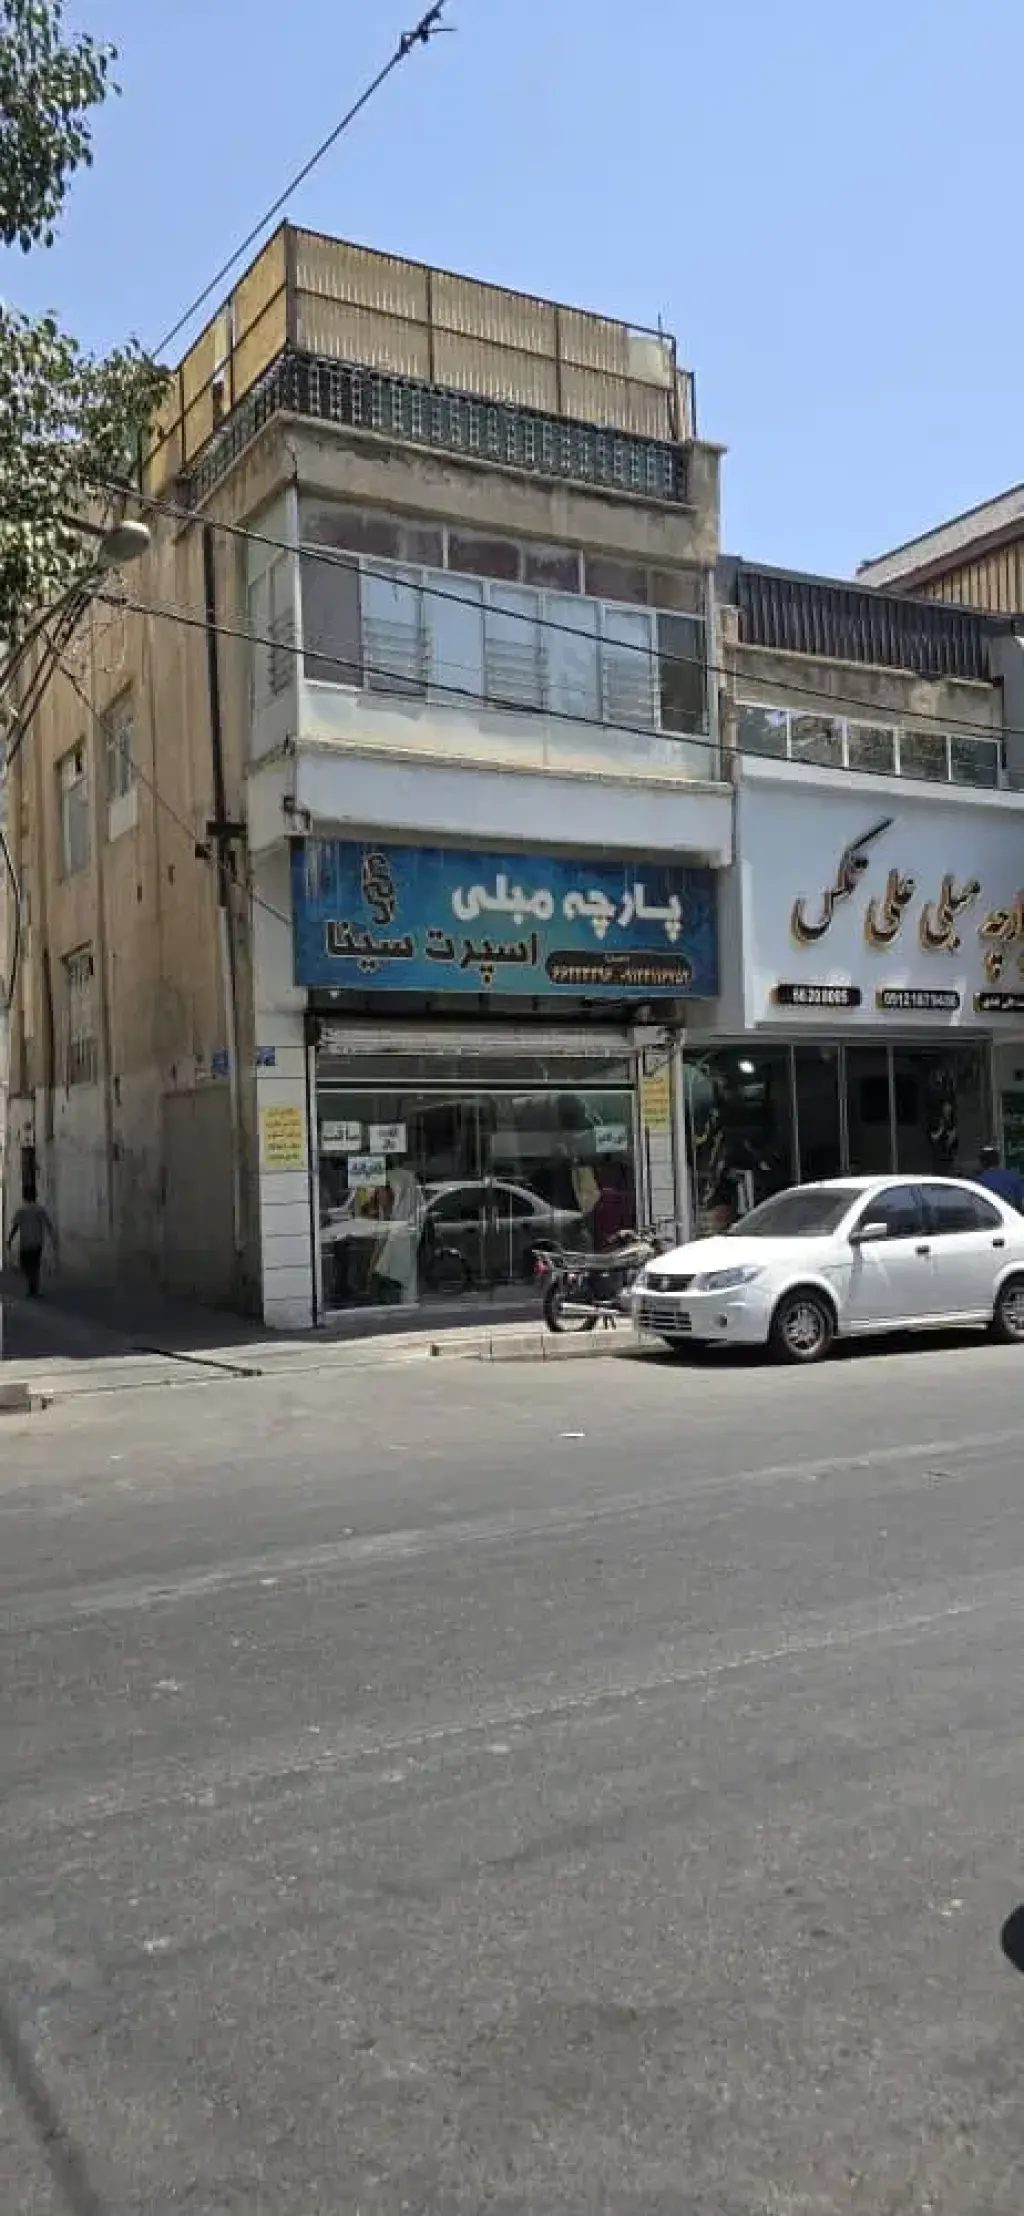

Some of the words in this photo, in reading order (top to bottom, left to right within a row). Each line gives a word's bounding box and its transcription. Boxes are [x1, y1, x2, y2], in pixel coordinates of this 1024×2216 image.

[451, 874, 554, 925] مبلی
[563, 883, 683, 941] پارچه
[790, 815, 896, 950] تکس
[863, 867, 917, 952] علی
[918, 873, 981, 955] مبلی
[326, 920, 414, 973] سینا
[425, 928, 540, 989] اسپرت
[977, 886, 1024, 983] ارچه
